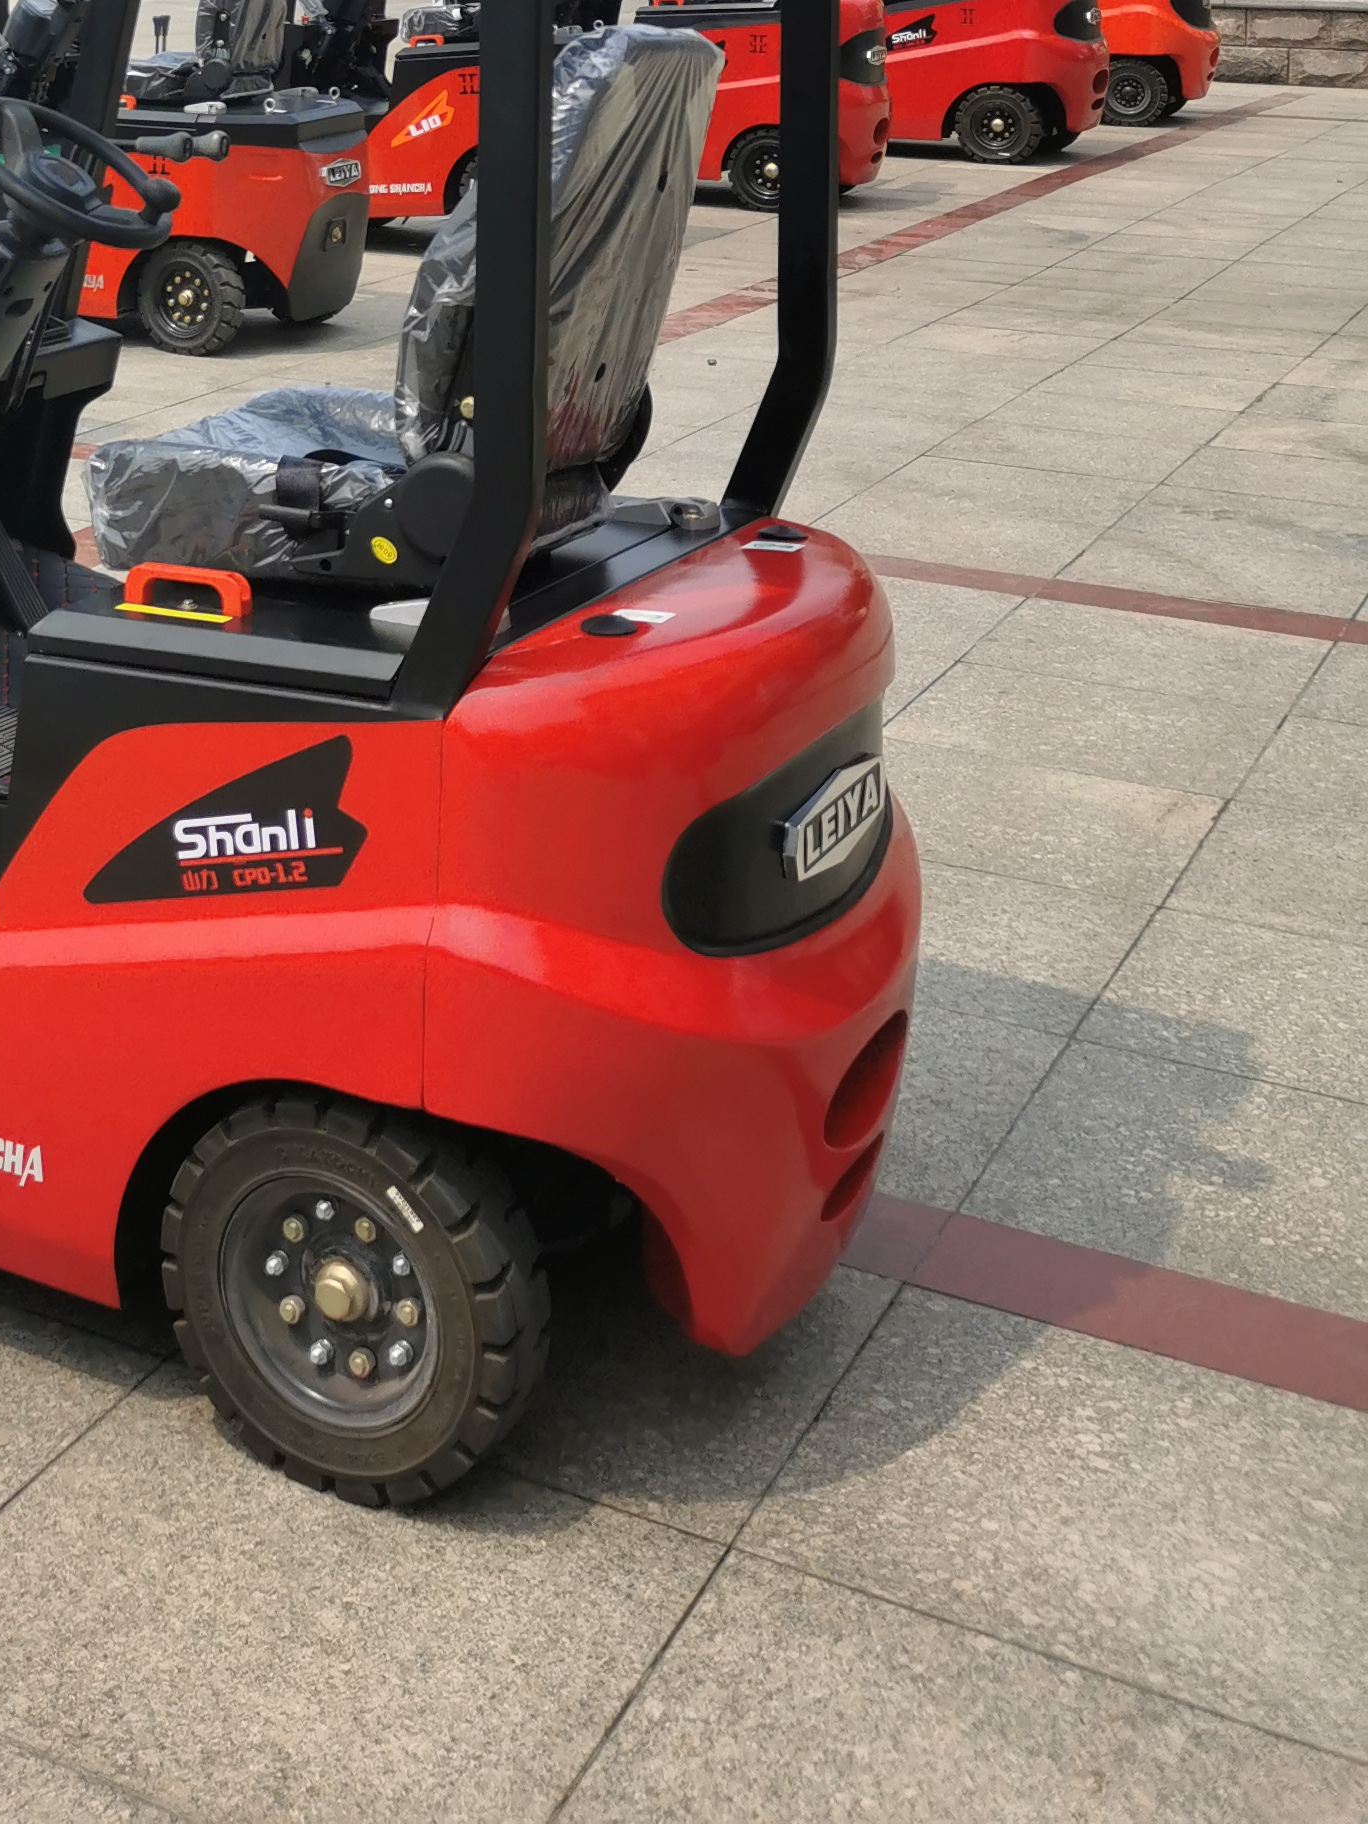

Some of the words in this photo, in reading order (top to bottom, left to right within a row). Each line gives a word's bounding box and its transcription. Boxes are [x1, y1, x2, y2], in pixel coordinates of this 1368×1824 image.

[174, 808, 316, 861] Shanli
[805, 772, 879, 869] LEIYA
[182, 868, 220, 892] 山力
